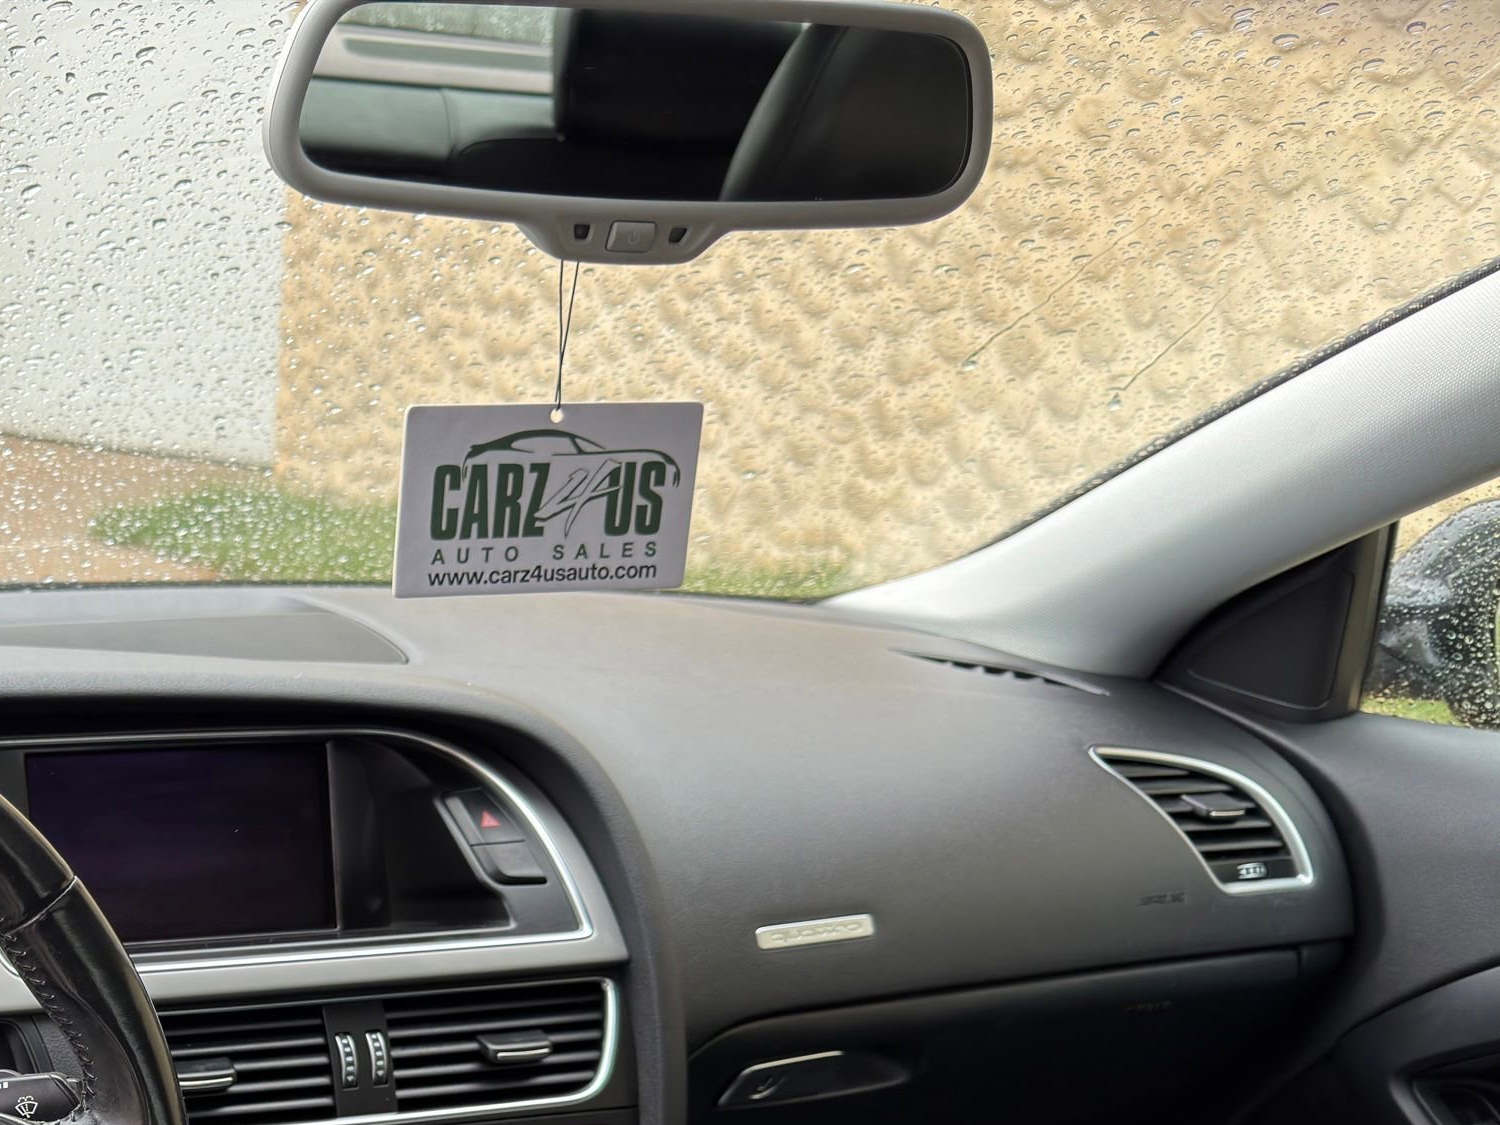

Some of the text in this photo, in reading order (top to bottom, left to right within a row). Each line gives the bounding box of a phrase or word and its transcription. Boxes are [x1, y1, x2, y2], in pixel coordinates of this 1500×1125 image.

[431, 540, 658, 566] AUTO SALES
[428, 561, 658, 588] www.carz4usauto.com
